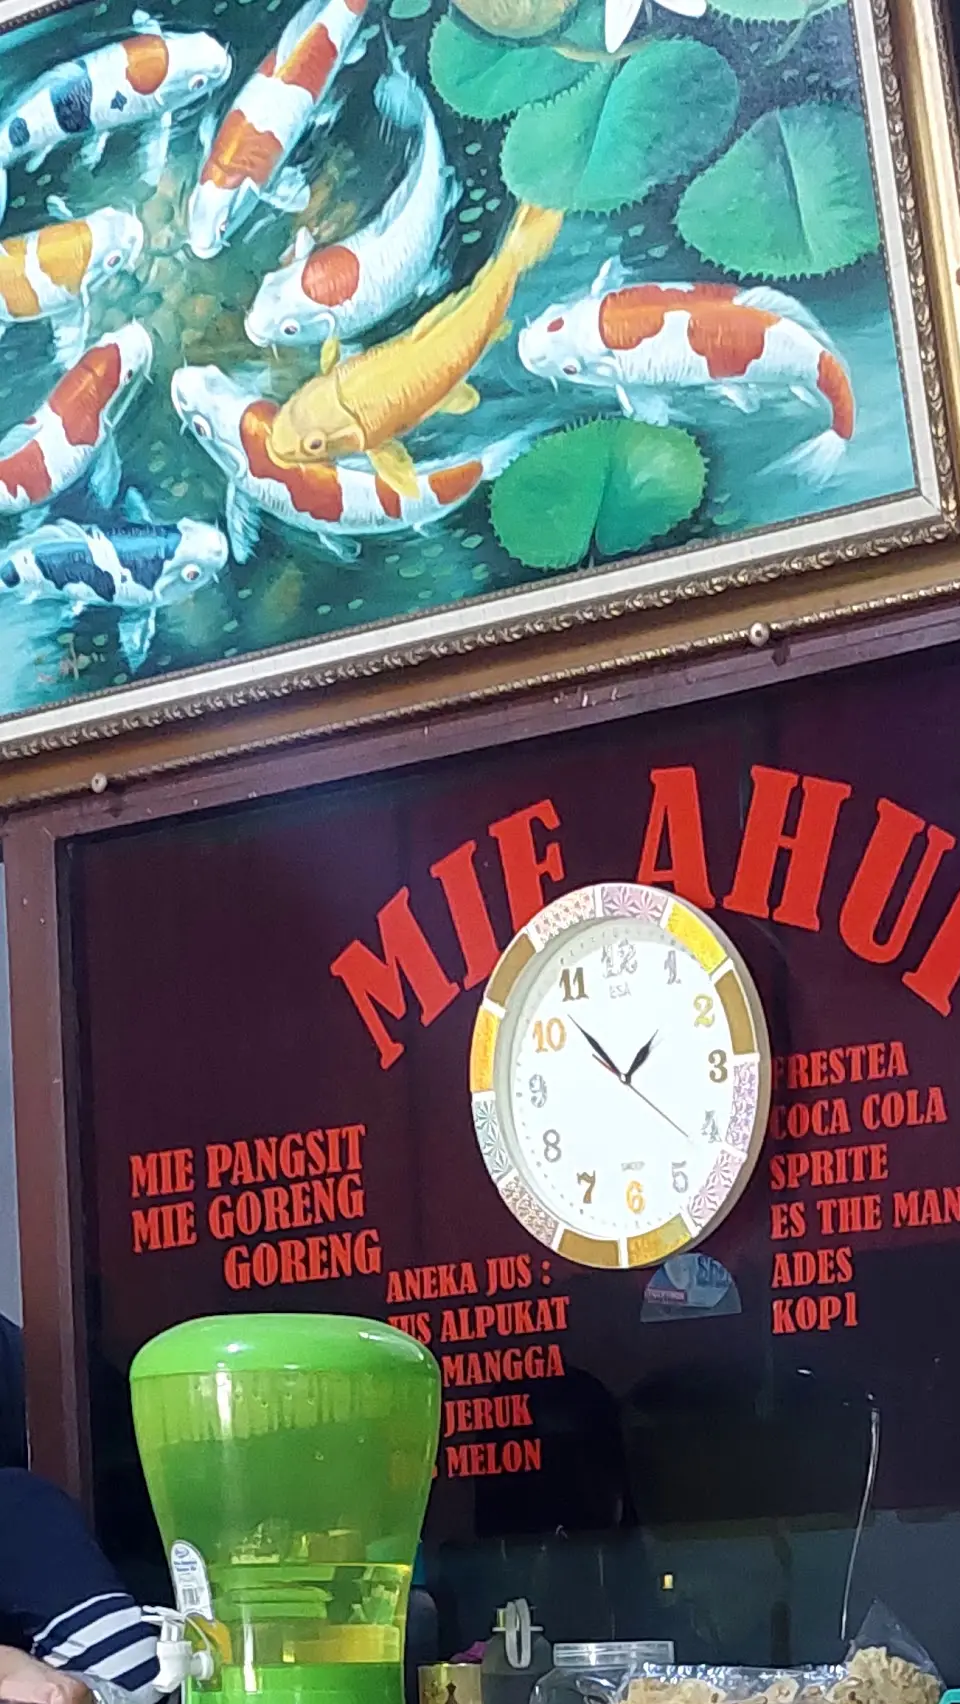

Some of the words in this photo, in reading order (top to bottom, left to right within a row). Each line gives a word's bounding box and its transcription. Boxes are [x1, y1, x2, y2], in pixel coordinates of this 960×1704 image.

[559, 967, 589, 1001] 11
[694, 994, 716, 1028] 2
[532, 1018, 567, 1053] 10
[707, 1049, 728, 1083] 3
[770, 1098, 851, 1140] COCA
[862, 1086, 948, 1131] COLA
[130, 1148, 195, 1199] MIE
[206, 1124, 366, 1188] PANGSIT
[542, 1129, 562, 1163] 8
[770, 1143, 889, 1191] SPRITE
[576, 1171, 597, 1204] 7
[625, 1180, 646, 1214] 6
[132, 1201, 197, 1253] MIE
[209, 1173, 365, 1239] GORENG
[770, 1201, 805, 1240] ES
[817, 1194, 883, 1235] THE
[224, 1229, 382, 1290] GORENG
[387, 1262, 478, 1304] ANEKA
[485, 1254, 532, 1296] JUS
[771, 1246, 853, 1289] ADES
[440, 1296, 570, 1343] ALPUKAT
[772, 1292, 858, 1335] KOPI
[442, 1344, 565, 1387] MANGGA
[444, 1394, 533, 1438] JERUK
[446, 1439, 542, 1478] MELON
